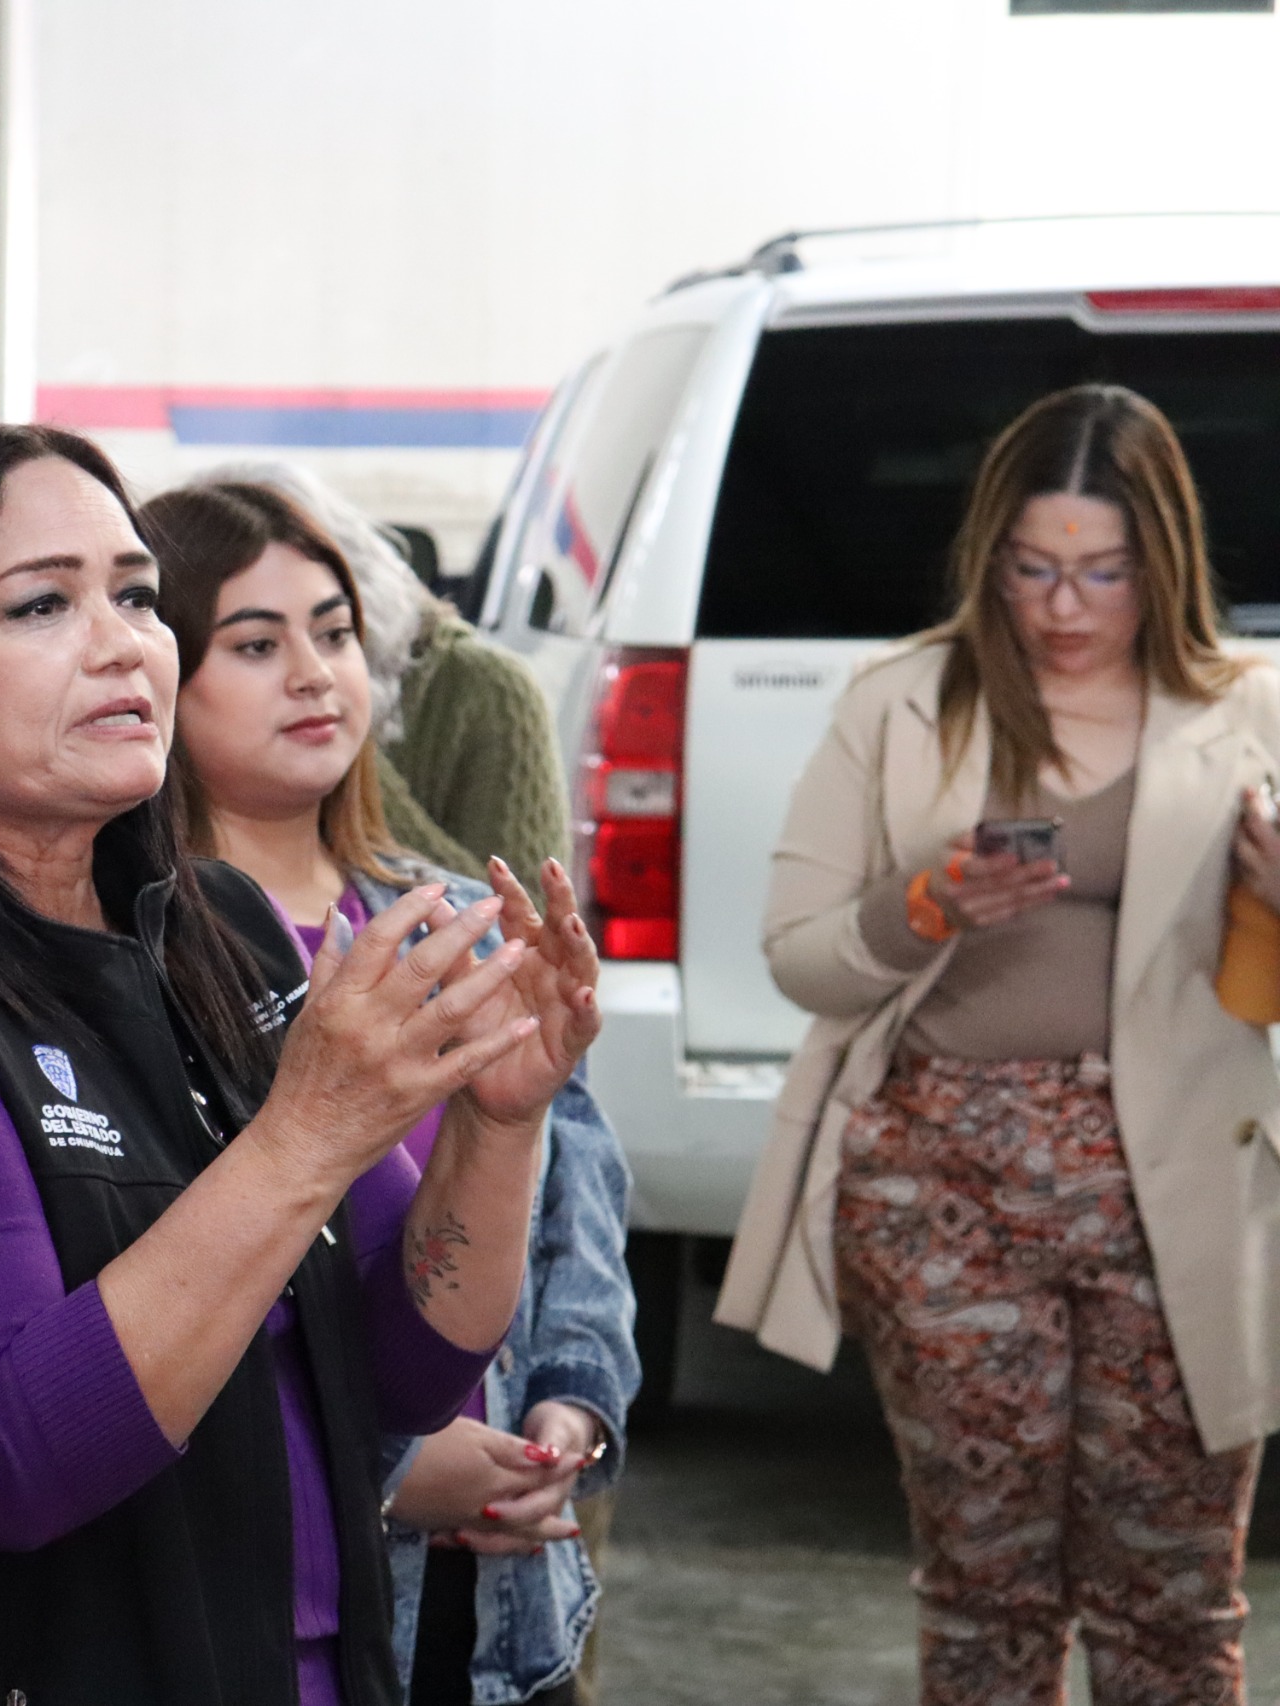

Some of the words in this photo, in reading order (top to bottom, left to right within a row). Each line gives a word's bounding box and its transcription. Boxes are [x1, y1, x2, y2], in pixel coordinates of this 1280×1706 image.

[41, 1119, 74, 1133] DEL
[71, 1121, 121, 1143] ESTADO
[49, 1137, 67, 1147] DE
